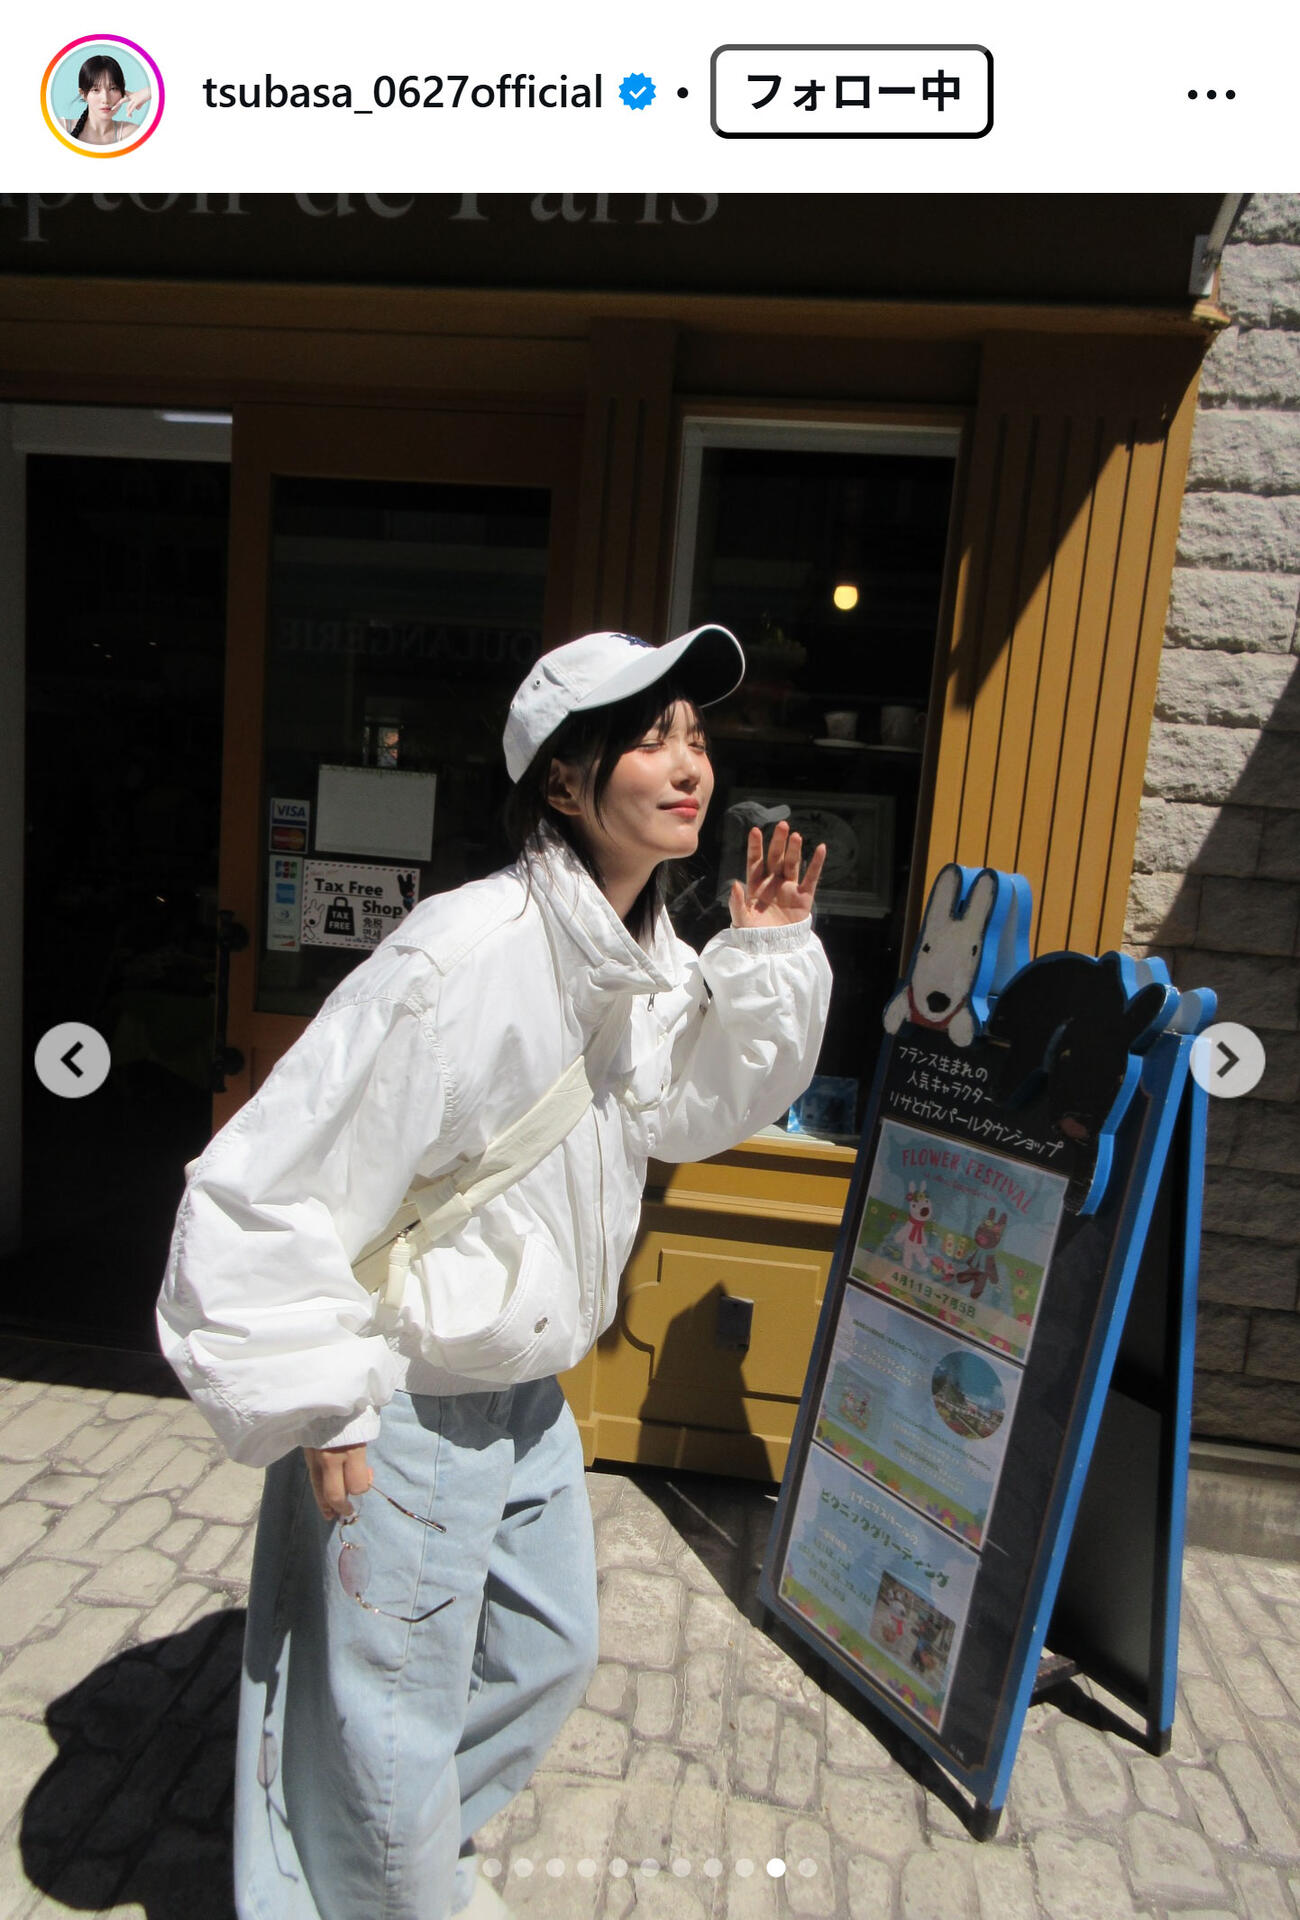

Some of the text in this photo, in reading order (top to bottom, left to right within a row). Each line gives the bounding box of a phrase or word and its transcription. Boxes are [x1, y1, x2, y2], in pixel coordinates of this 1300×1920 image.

[277, 805, 306, 818] VISA
[314, 878, 384, 897] Tax Free
[331, 910, 349, 921] TAX
[362, 900, 403, 919] Shop
[328, 920, 352, 932] FREE
[898, 1046, 988, 1083] フランス生まれの
[906, 1070, 994, 1104] 人気キャラクター
[889, 1090, 1065, 1158] リサとガスパールタウンショップ
[902, 1149, 960, 1170] FLOWER
[966, 1159, 1034, 1215] FESTIVAL
